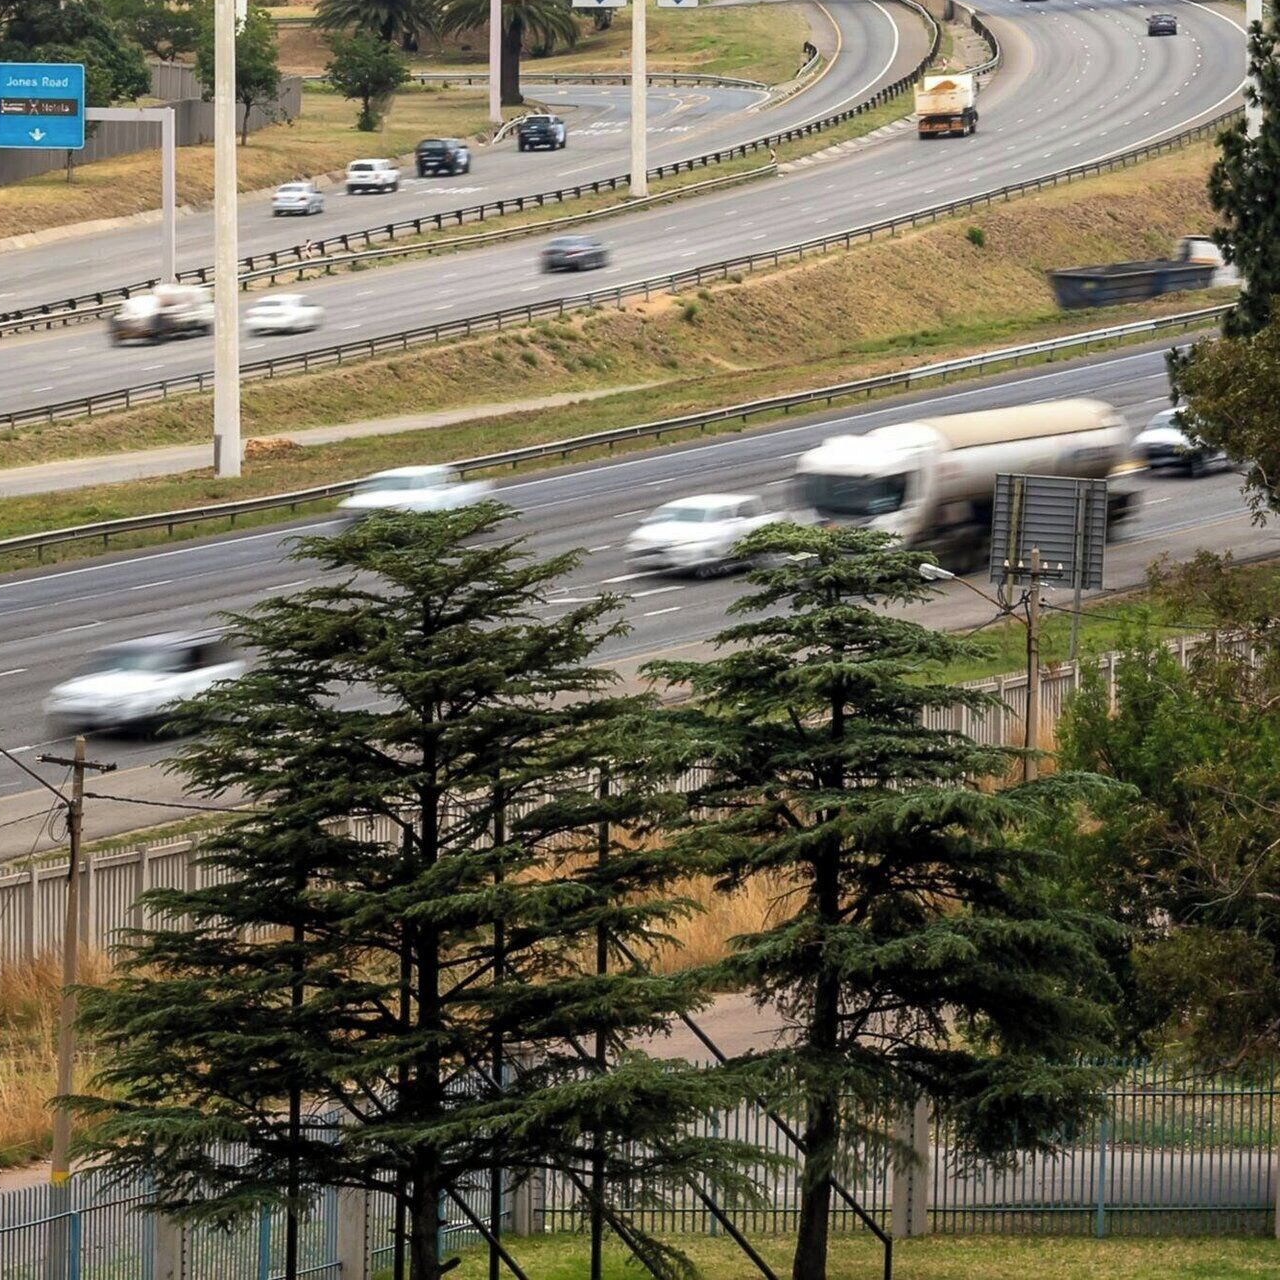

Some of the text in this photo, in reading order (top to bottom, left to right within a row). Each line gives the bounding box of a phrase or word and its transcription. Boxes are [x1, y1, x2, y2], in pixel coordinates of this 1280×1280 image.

[6, 76, 69, 87] Jones Road
[41, 103, 70, 112] Hotels
